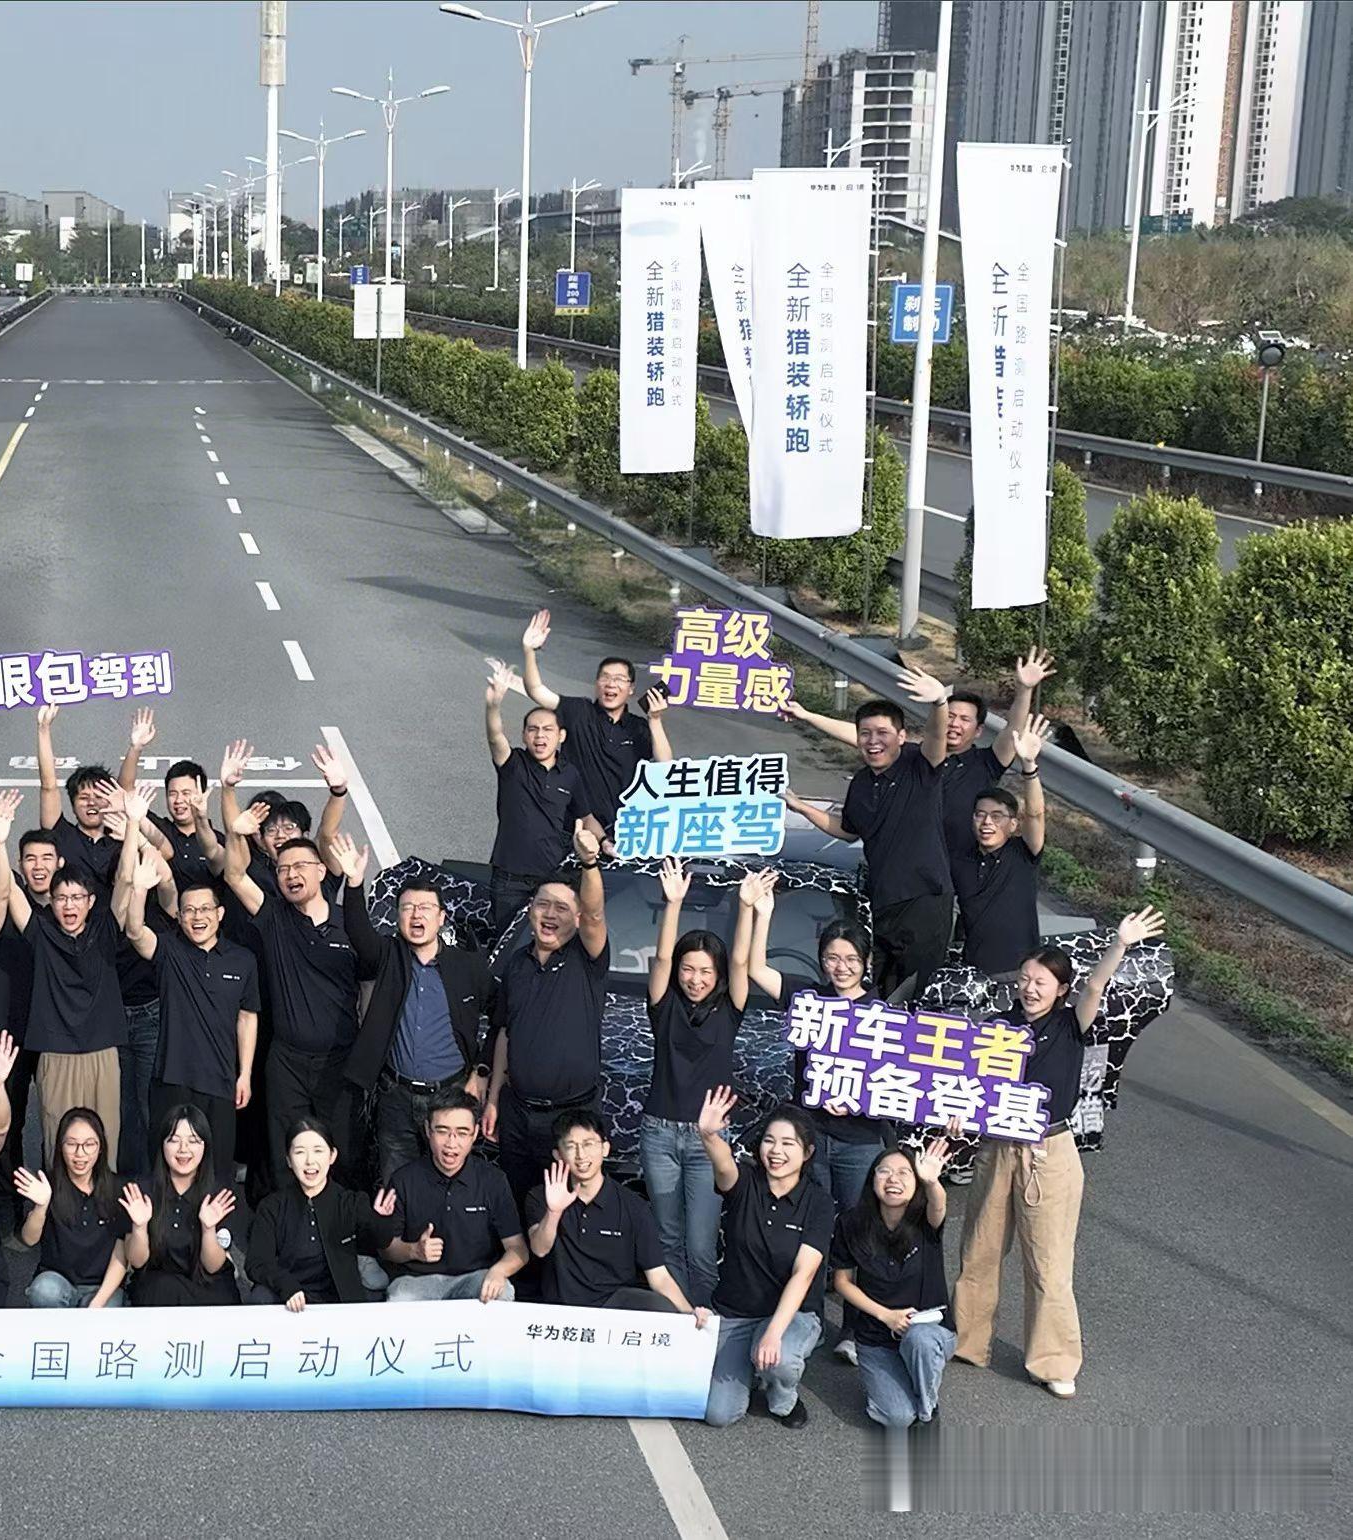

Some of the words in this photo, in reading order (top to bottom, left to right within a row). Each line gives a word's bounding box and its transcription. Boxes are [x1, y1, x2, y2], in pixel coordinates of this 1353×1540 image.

[647, 260, 666, 408] 全新猎装轿跑
[786, 262, 811, 453] 全新猎装轿跑
[676, 608, 770, 660] 高级
[649, 657, 792, 712] 力量感
[622, 757, 785, 801] 人生值得
[617, 801, 784, 857] 新座驾
[786, 992, 1032, 1082] 新车王者
[804, 1052, 1048, 1141] 预备登基
[526, 1323, 596, 1344] 华为乾崑
[621, 1330, 672, 1347] 启境
